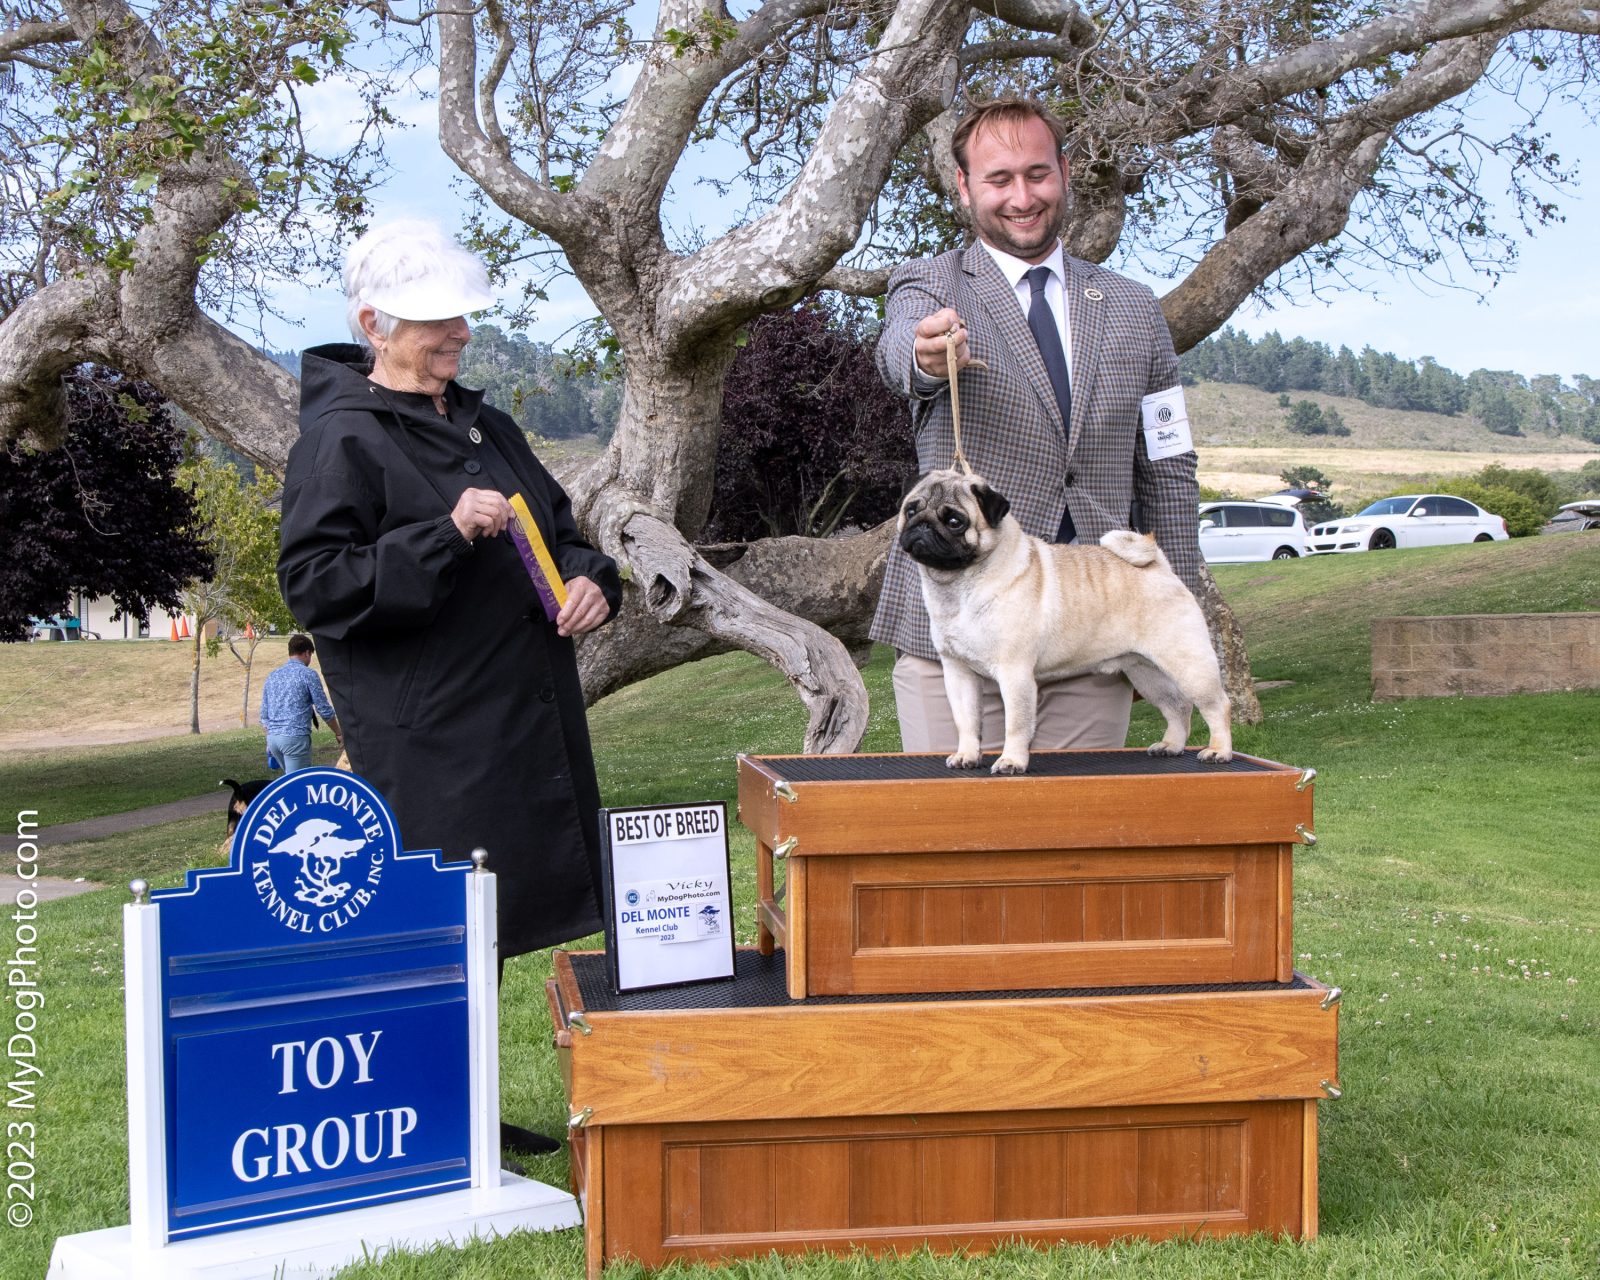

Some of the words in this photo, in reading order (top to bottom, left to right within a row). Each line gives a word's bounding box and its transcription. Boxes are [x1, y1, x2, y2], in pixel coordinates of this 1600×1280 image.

[253, 797, 298, 848] DEL
[306, 783, 384, 843] MONTE
[616, 815, 650, 842] BEST
[653, 813, 672, 838] OF
[675, 809, 719, 836] BREED
[252, 860, 314, 933] KENNEL
[318, 888, 377, 932] CLUB,
[367, 848, 384, 885] INC.
[657, 891, 721, 903] MyDogPhoto.com
[666, 878, 713, 892] Vicky
[621, 910, 644, 924] DEL
[647, 906, 690, 921] MONTE
[635, 924, 661, 934] Kennel
[662, 923, 678, 932] Club
[271, 1030, 383, 1095] TOY
[231, 1106, 418, 1183] GROUP
